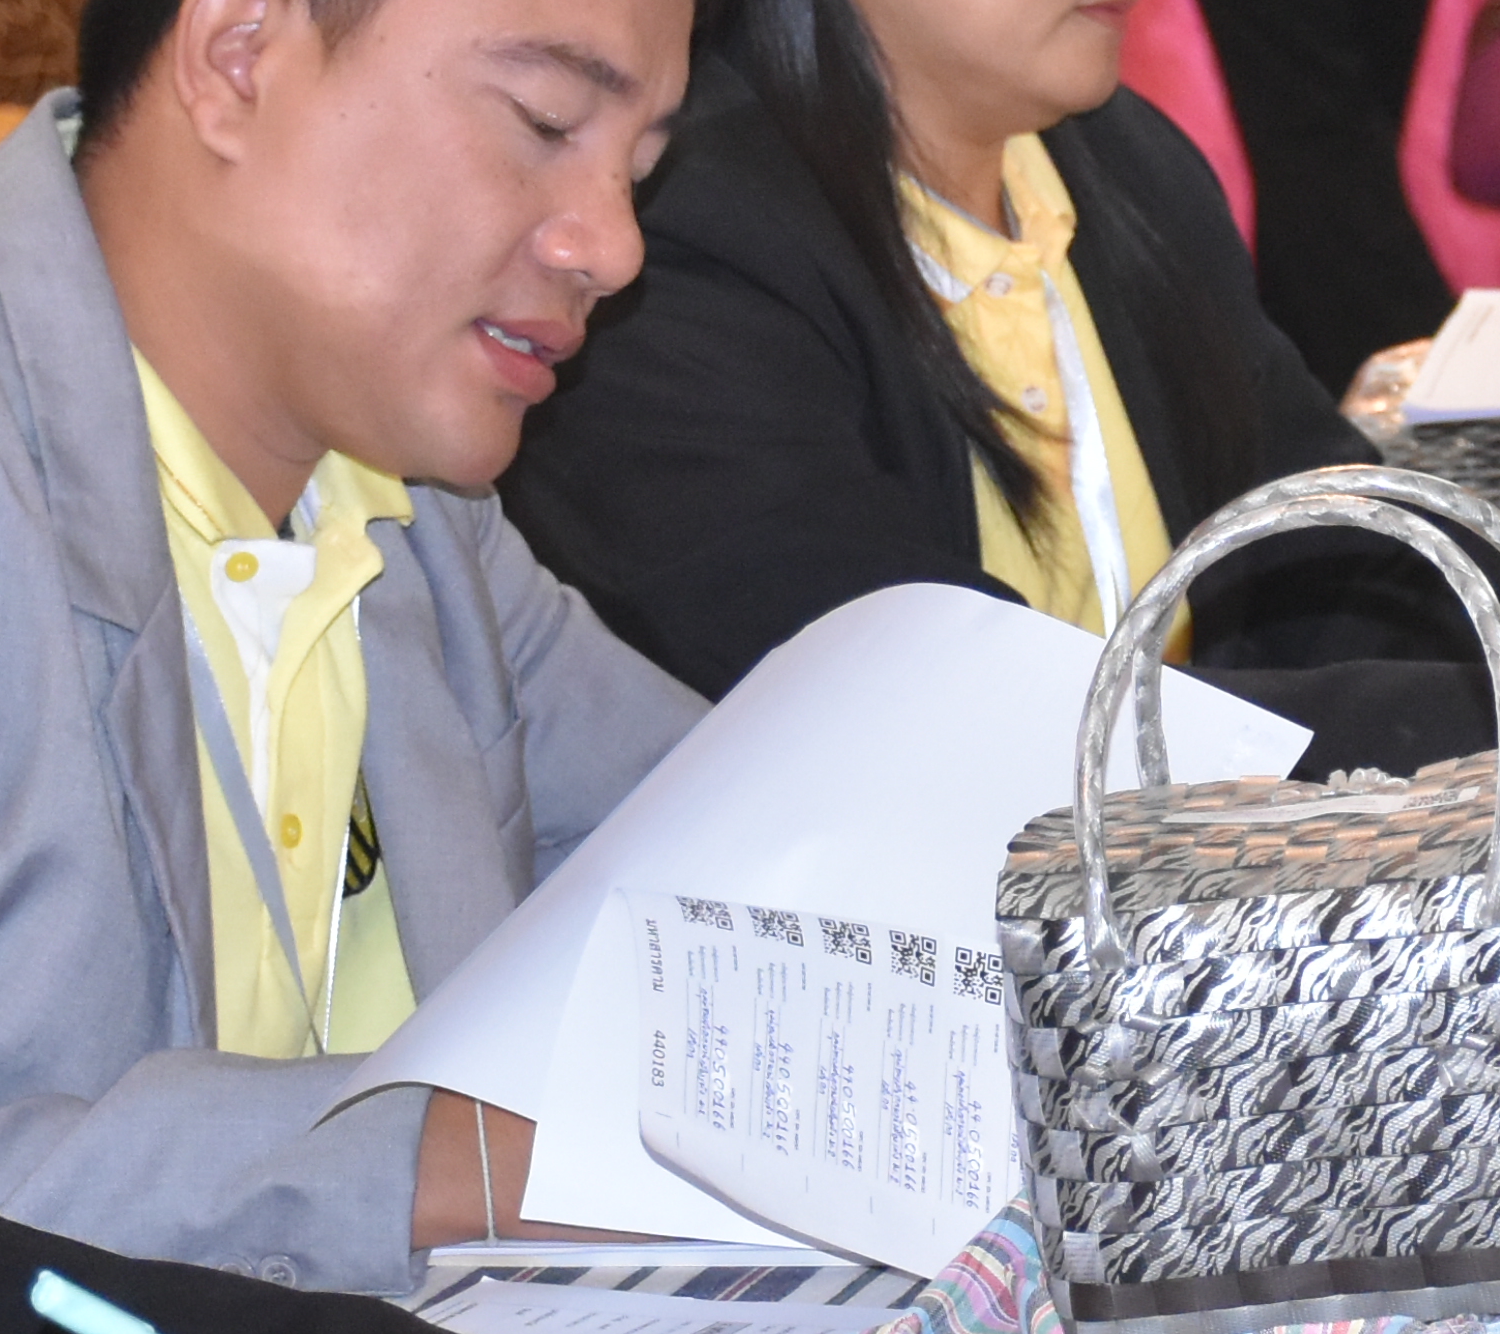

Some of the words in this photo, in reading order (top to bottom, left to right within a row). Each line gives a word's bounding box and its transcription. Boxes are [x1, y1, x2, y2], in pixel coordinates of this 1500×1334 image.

[645, 919, 665, 992] มหาสารคาม
[652, 1029, 666, 1087] 440183
